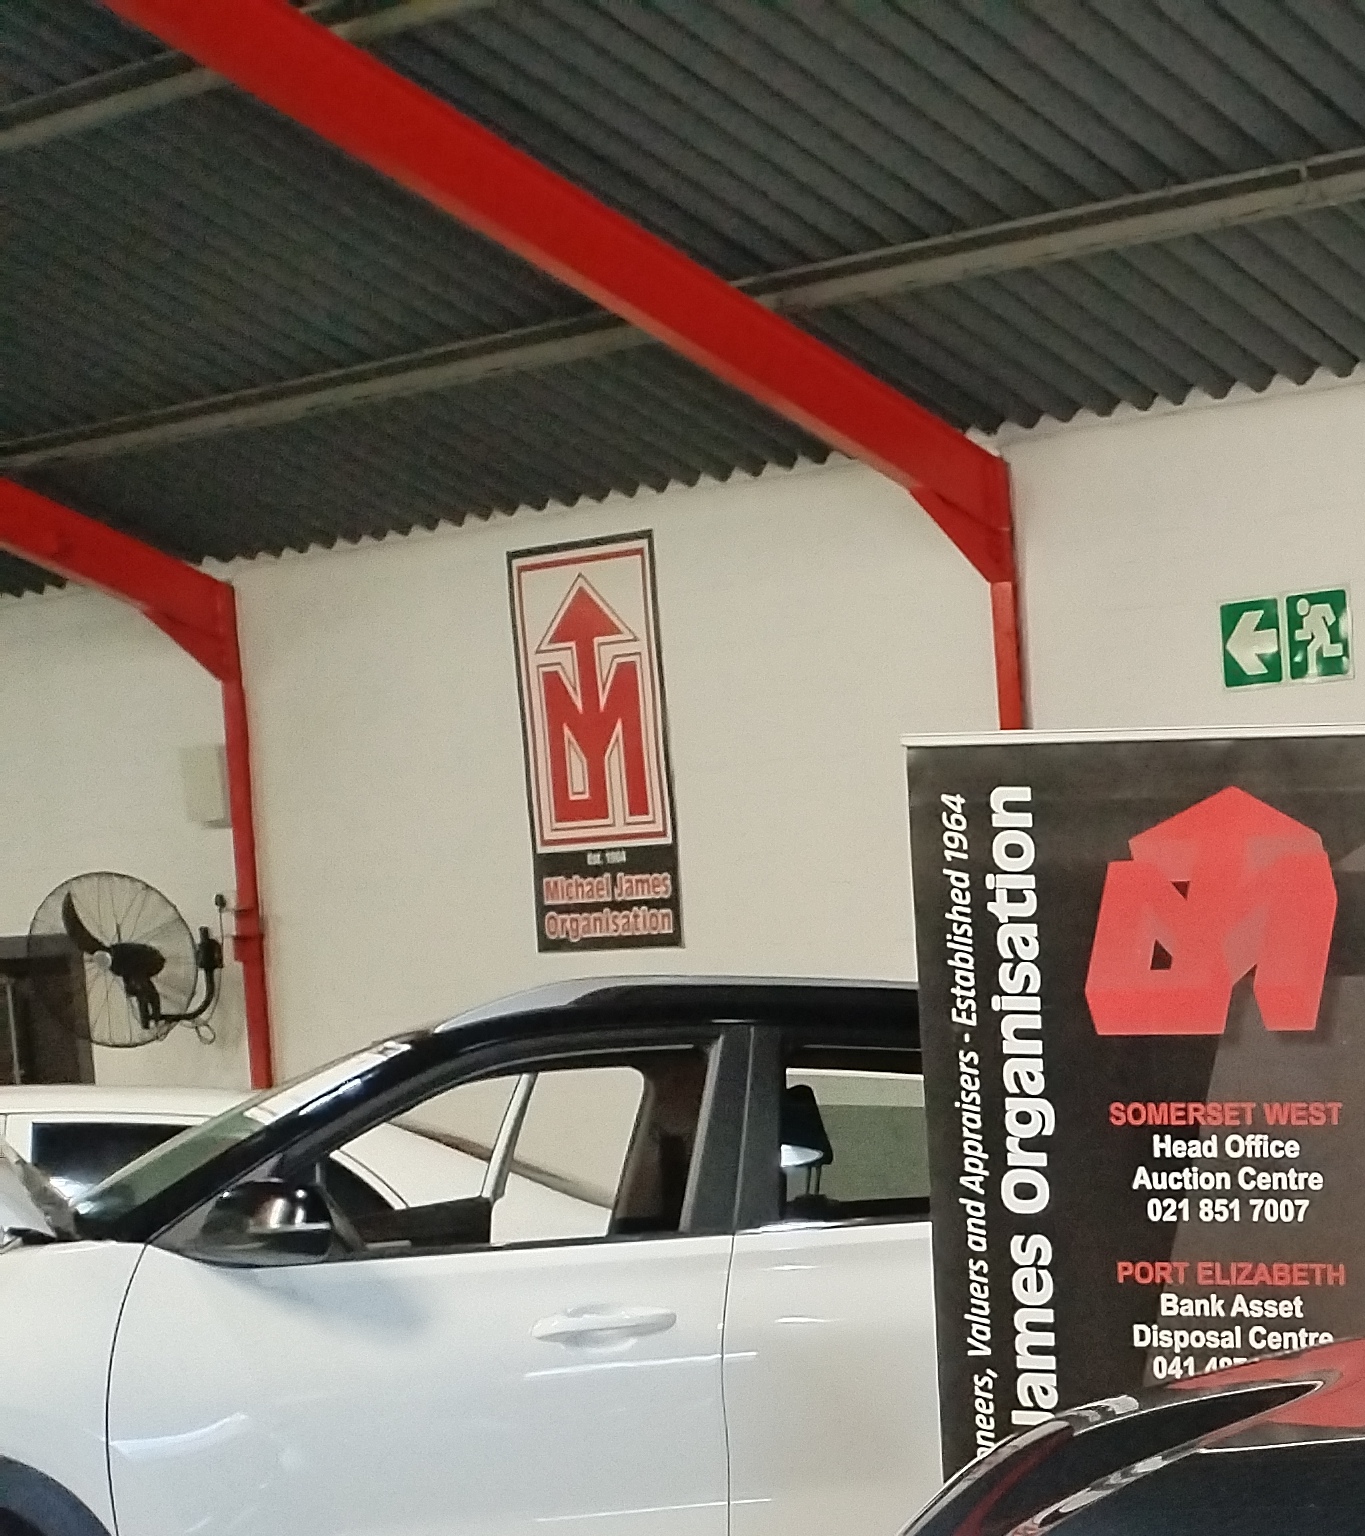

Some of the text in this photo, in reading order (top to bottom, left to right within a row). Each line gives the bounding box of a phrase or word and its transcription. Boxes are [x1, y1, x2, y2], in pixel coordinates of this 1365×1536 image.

[940, 793, 969, 862] 1964
[543, 872, 672, 905] Michael James
[545, 906, 673, 942] Organisation
[943, 869, 978, 1027] Established
[954, 1050, 989, 1195] Appraisers
[1109, 1102, 1343, 1126] SOMERSET WEST
[1152, 1134, 1300, 1159] Head Office
[1132, 1166, 1324, 1191] Auction Centre
[1147, 1198, 1310, 1223] 021 851 7007
[959, 1198, 988, 1257] and
[1116, 1261, 1345, 1286] PORT ELIZABETH
[964, 1257, 992, 1357] Valuers
[1160, 1293, 1304, 1318] Bank Asset
[1133, 1323, 1242, 1354] Disposal
[1153, 1355, 1195, 1379] 041
